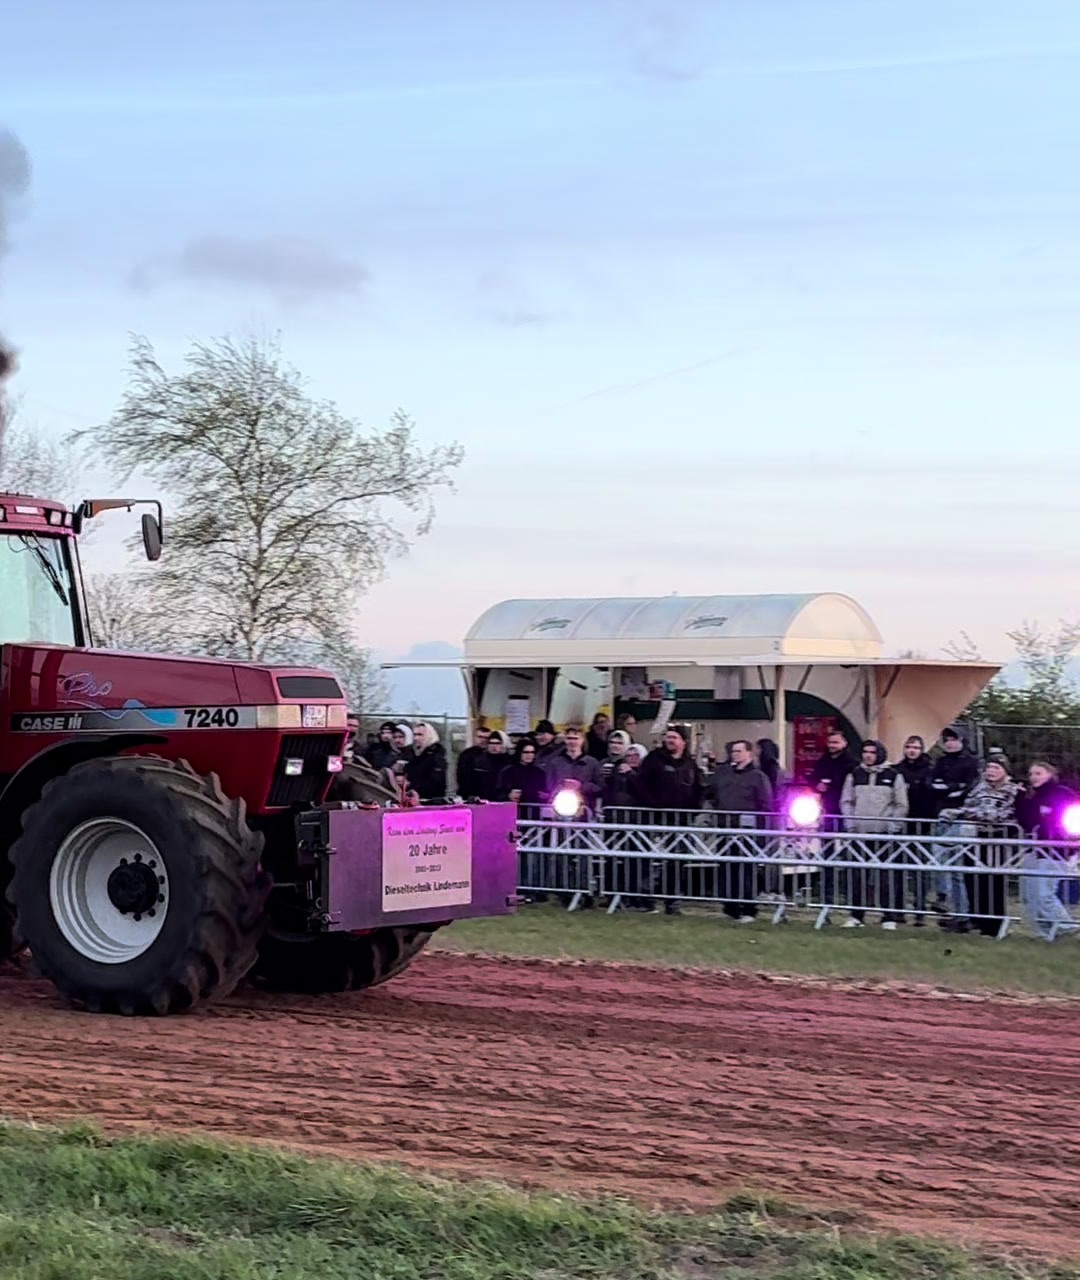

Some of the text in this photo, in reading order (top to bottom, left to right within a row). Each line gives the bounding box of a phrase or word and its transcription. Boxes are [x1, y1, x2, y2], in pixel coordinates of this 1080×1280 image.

[20, 717, 64, 731] CASE
[184, 708, 239, 728] 7240
[408, 842, 448, 857] 20 Jahre
[384, 880, 470, 896] Dieseltechnik Lindemann
